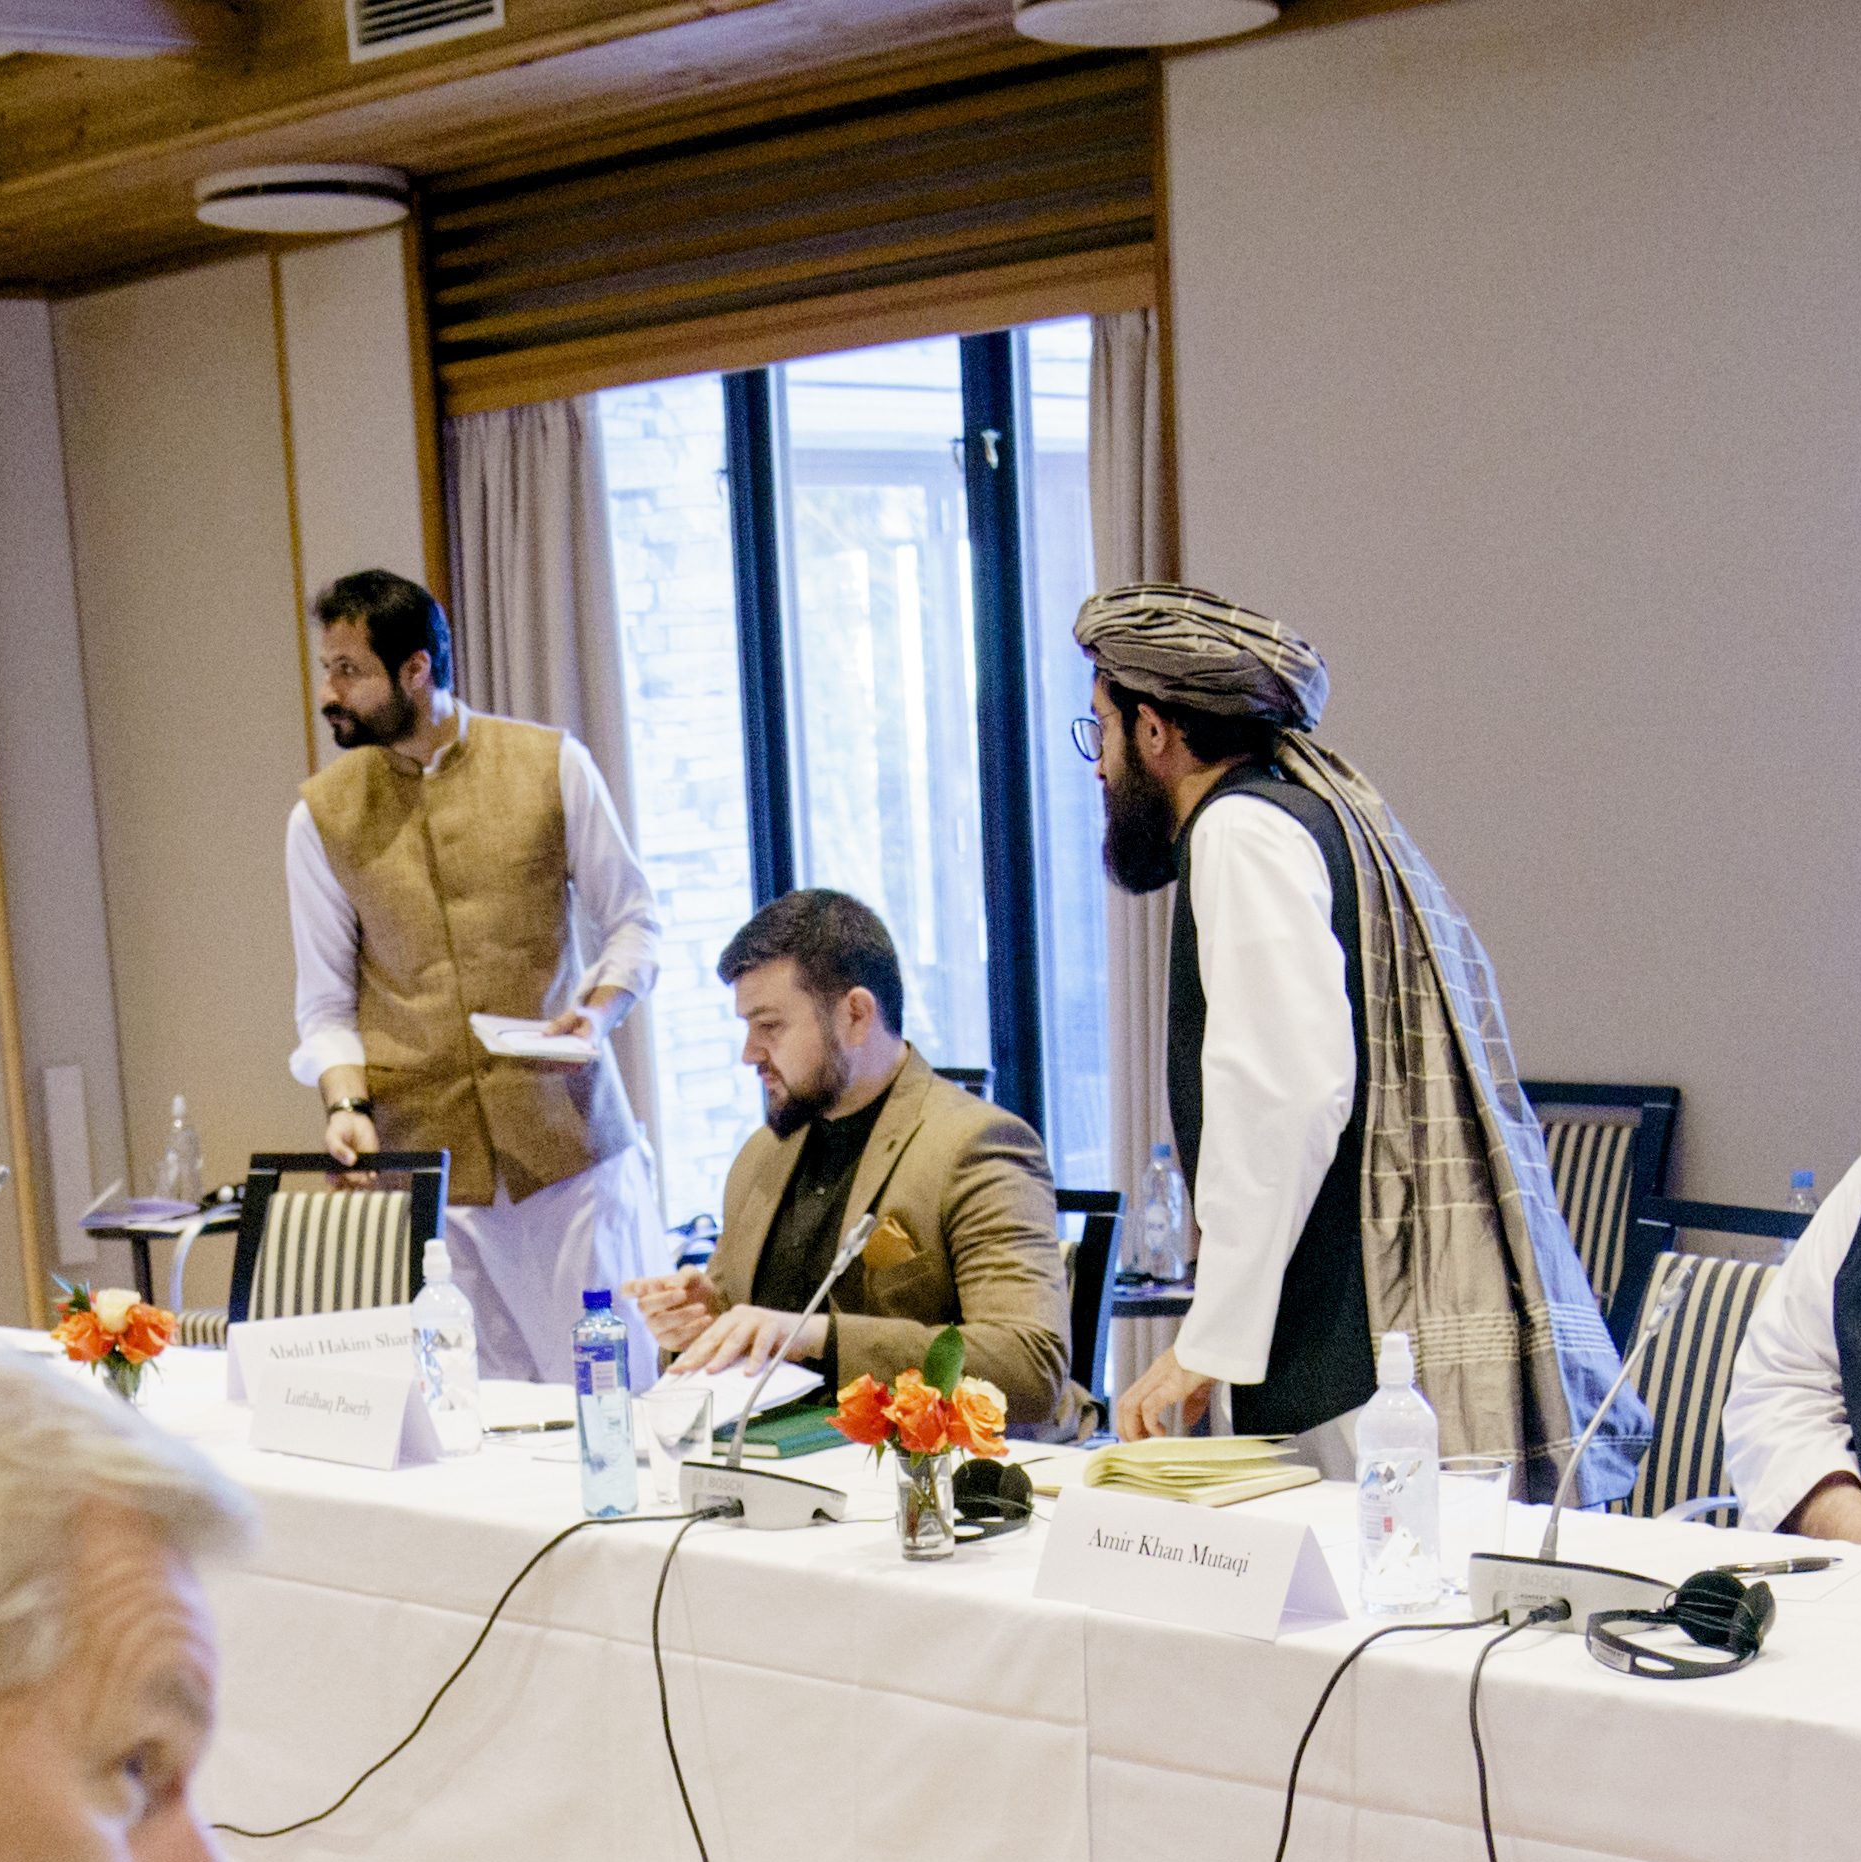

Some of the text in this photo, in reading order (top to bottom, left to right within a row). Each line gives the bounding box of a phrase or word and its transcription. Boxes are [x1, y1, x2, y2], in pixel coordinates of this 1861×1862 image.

[269, 1342, 315, 1360] Abdul
[317, 1338, 371, 1355] Hakim
[708, 1475, 745, 1492] BOSCH
[1087, 1526, 1251, 1577] Amir Khan Mutaqi
[1518, 1572, 1572, 1592] BOSCH
